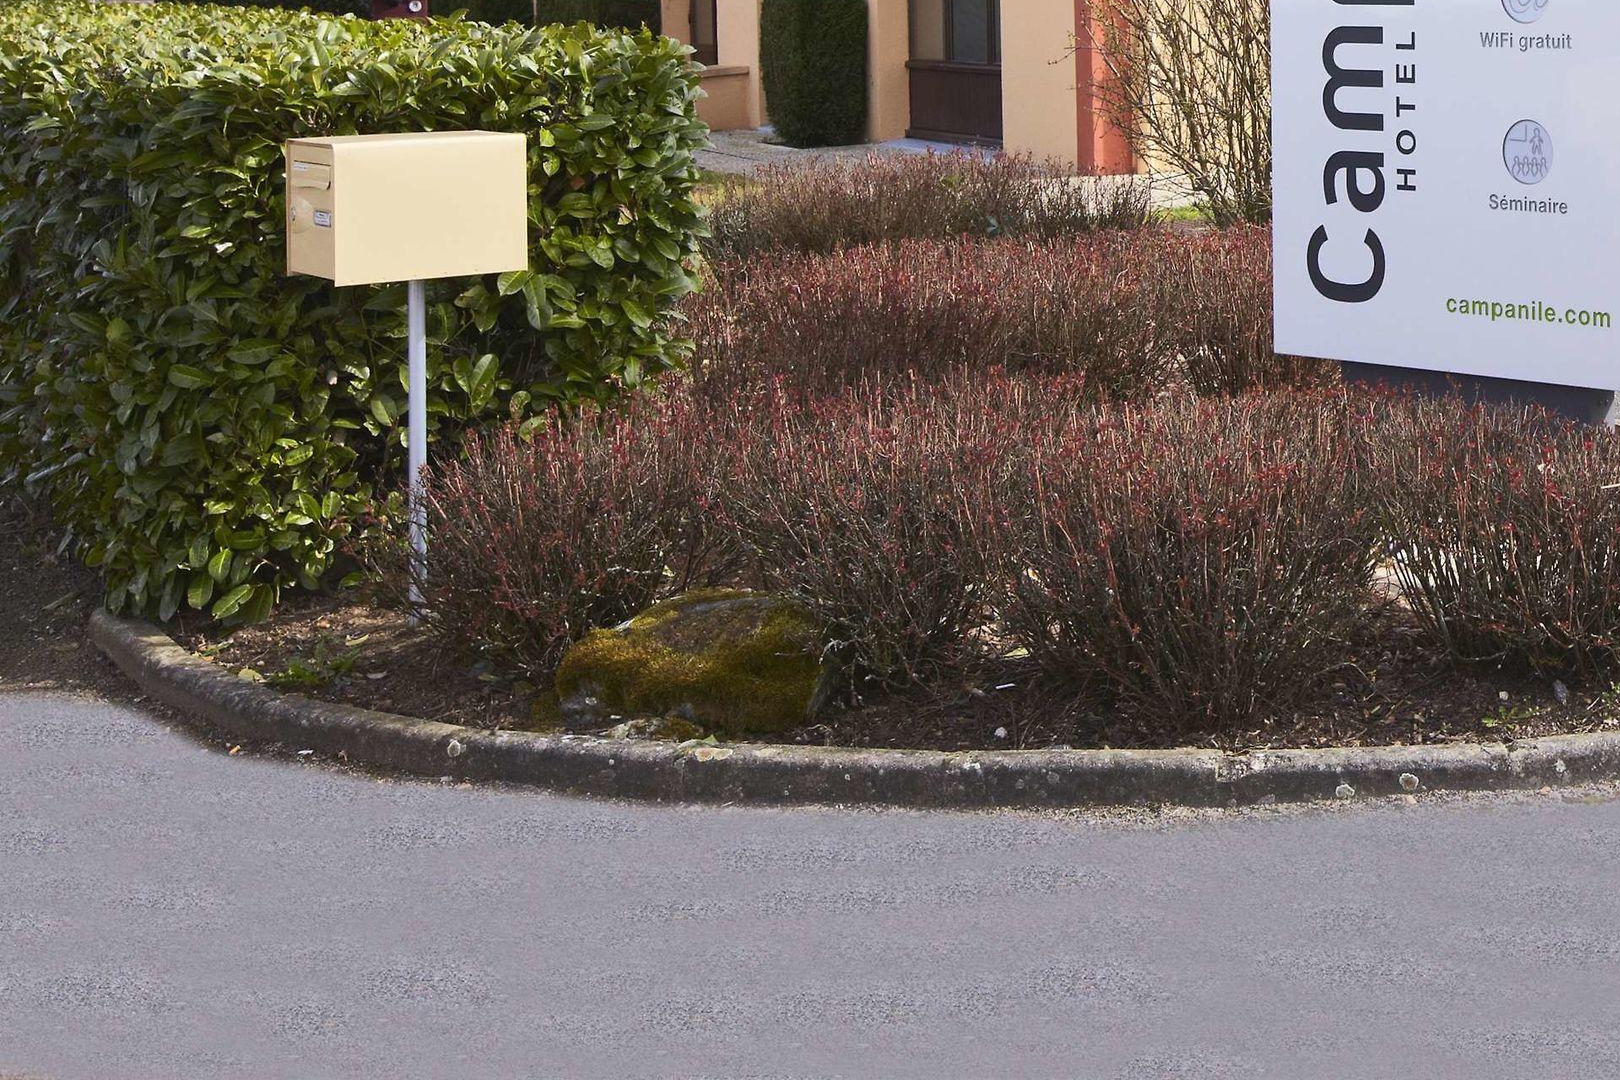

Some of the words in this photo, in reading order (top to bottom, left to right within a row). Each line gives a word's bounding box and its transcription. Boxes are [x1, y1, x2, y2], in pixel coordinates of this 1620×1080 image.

[1479, 31, 1515, 50] WiFi
[1518, 32, 1573, 52] gratuit
[1395, 31, 1417, 192] HOTEL
[1488, 193, 1569, 215] Séminaire
[1445, 296, 1612, 328] campanile.com
